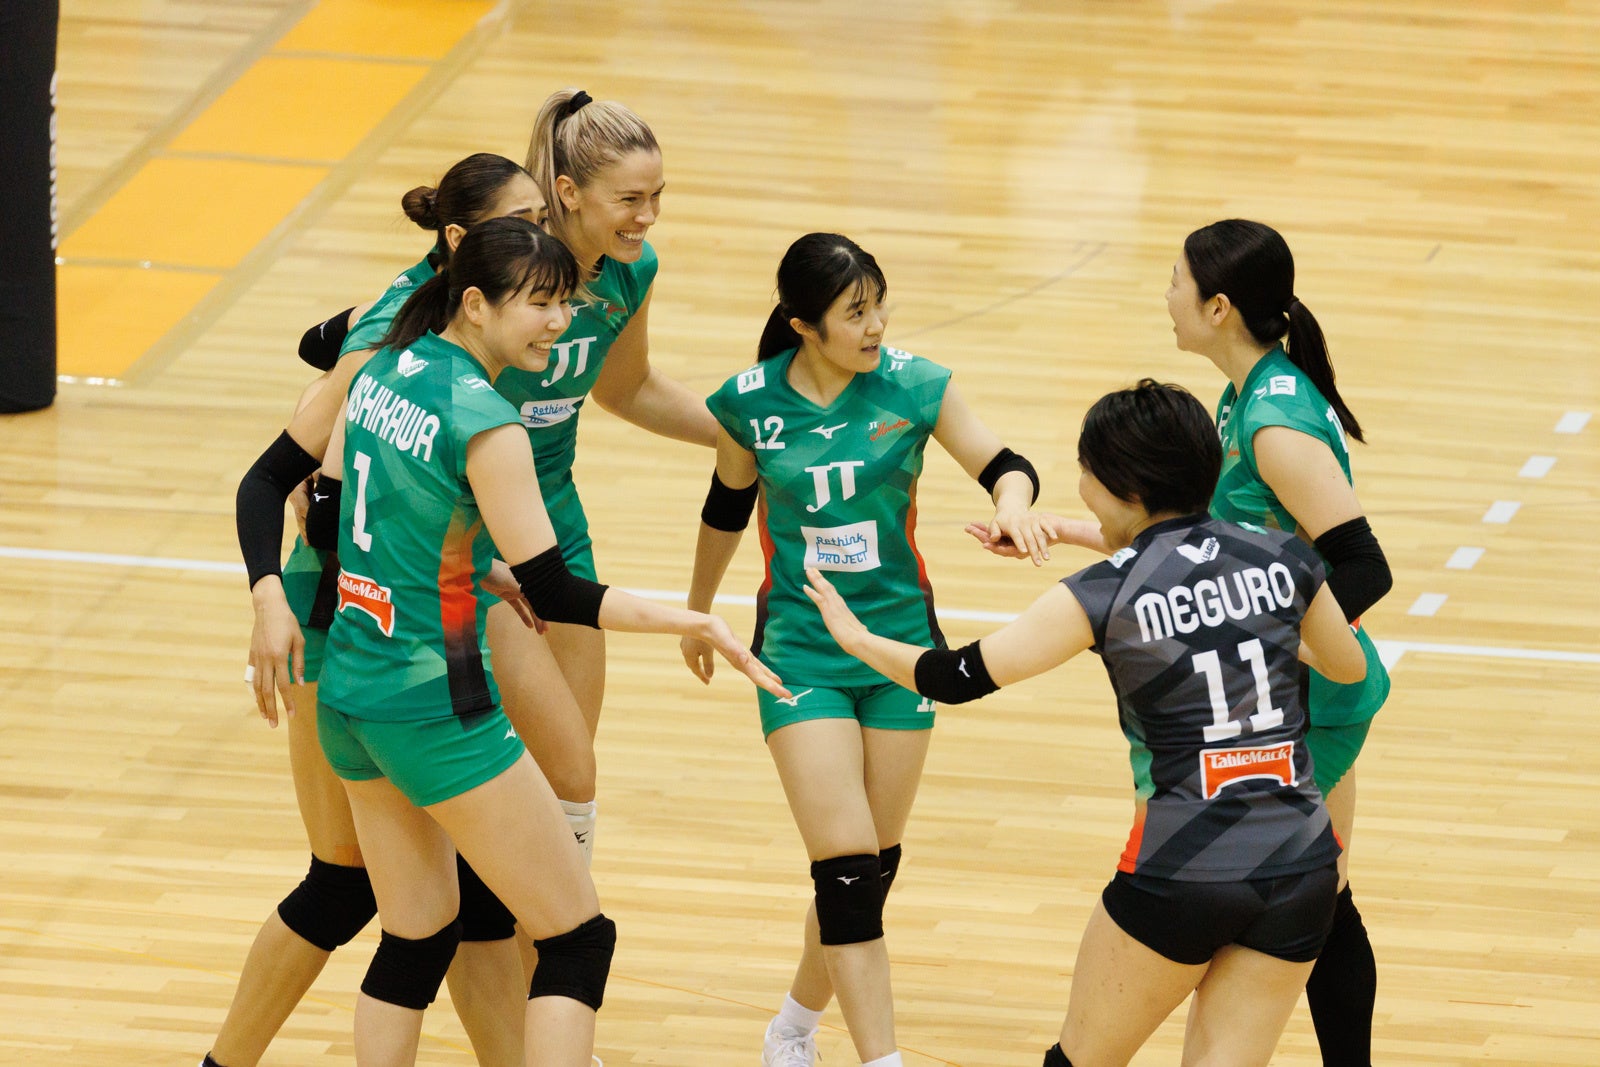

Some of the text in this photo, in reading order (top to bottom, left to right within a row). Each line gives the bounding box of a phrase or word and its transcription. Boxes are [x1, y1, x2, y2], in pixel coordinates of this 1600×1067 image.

[541, 336, 597, 388] JT
[887, 359, 906, 373] JT
[750, 415, 785, 450] 12
[353, 450, 373, 553] 1
[804, 460, 865, 513] JT
[816, 532, 864, 547] Rethink
[817, 551, 867, 564] PROJECT
[1134, 562, 1296, 643] MEGURO
[1191, 638, 1284, 743] 11
